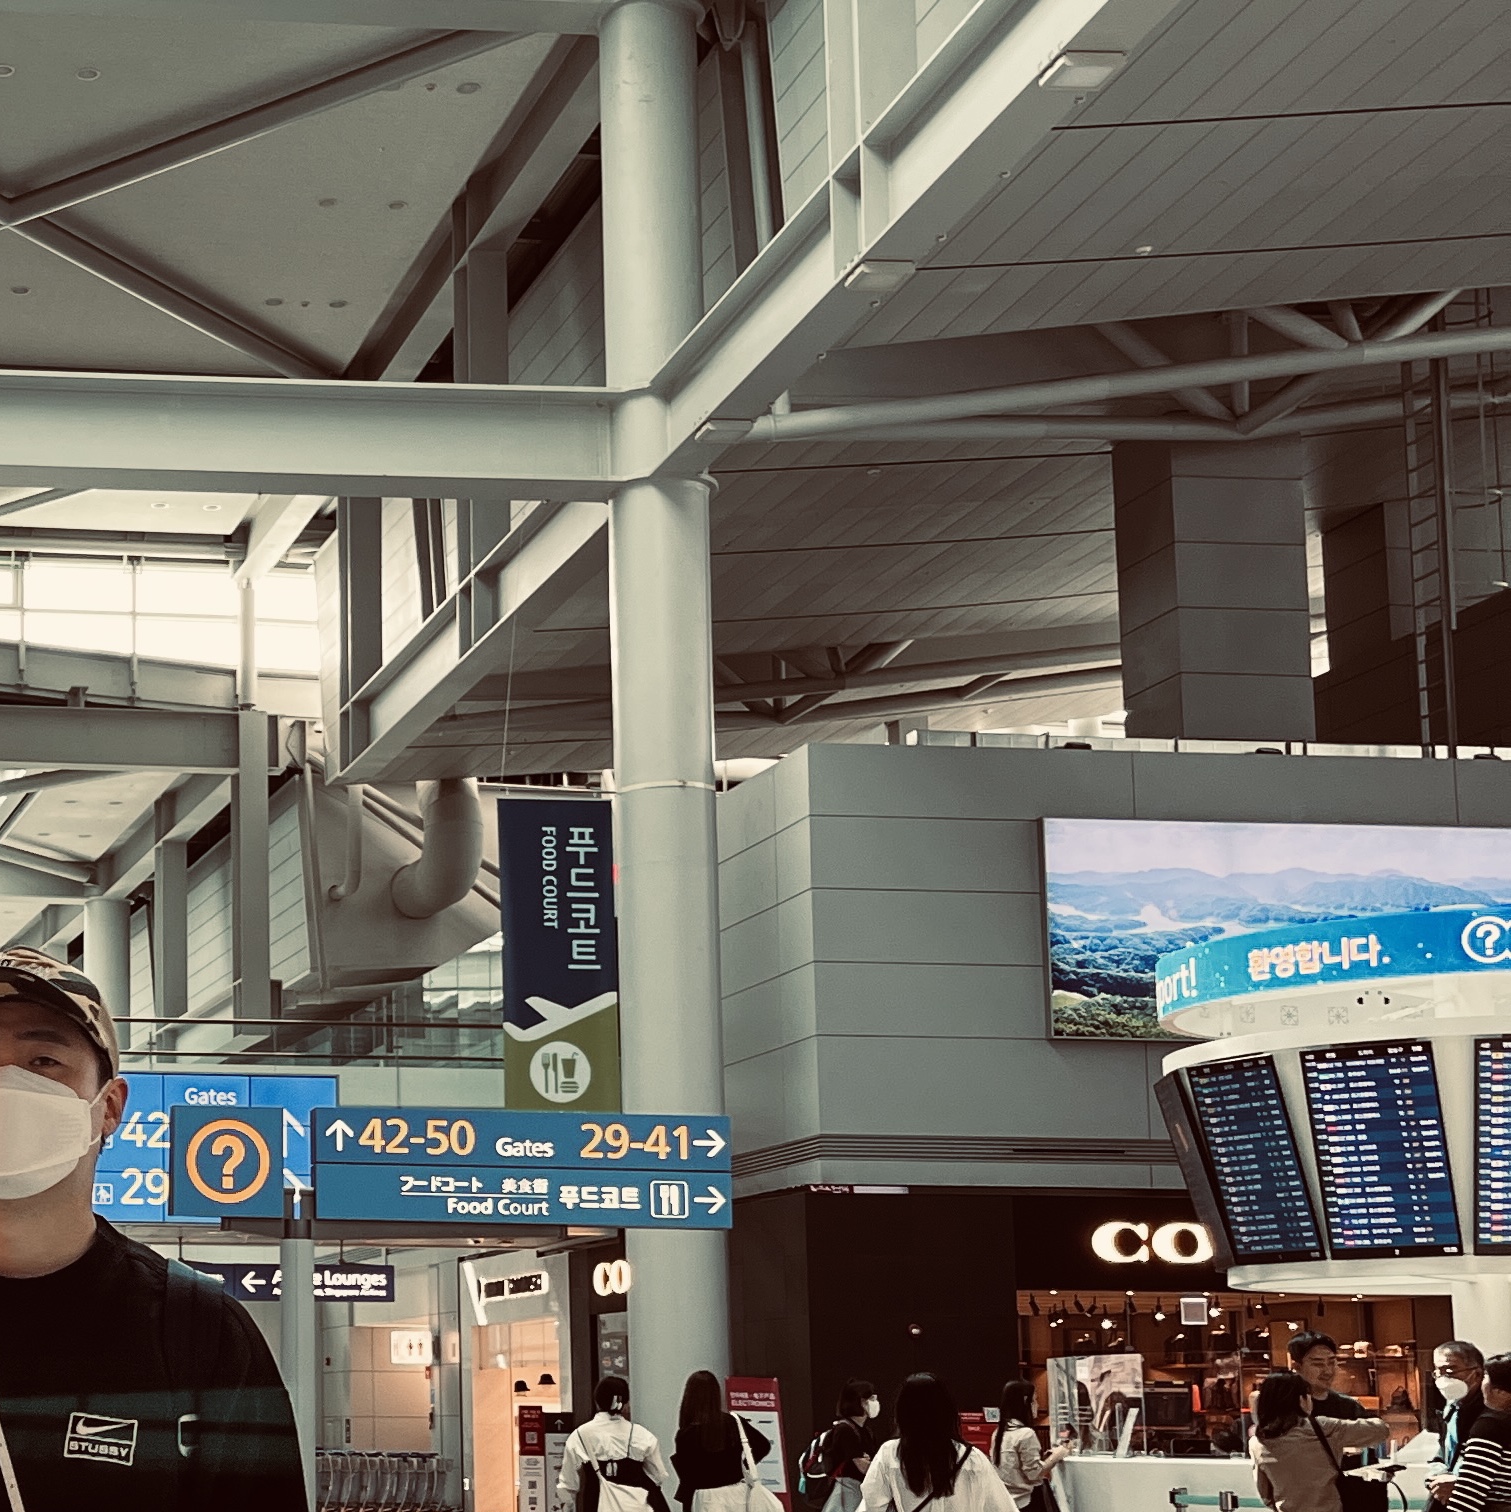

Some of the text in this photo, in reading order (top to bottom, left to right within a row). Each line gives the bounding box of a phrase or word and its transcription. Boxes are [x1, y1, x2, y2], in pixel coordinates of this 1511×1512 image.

[541, 826, 559, 929] FOOD COURT
[565, 826, 602, 970] 푸드코트
[1248, 933, 1391, 982] 환영합니다.
[184, 1087, 237, 1106] Gates
[120, 1111, 171, 1149] 42
[357, 1117, 689, 1160] 42-50 Gates 29-41
[120, 1167, 171, 1206] 29
[399, 1175, 484, 1193] フードコート
[558, 1185, 642, 1210] 푸드코트
[447, 1197, 550, 1216] Food Court
[324, 1270, 388, 1291] Lounges
